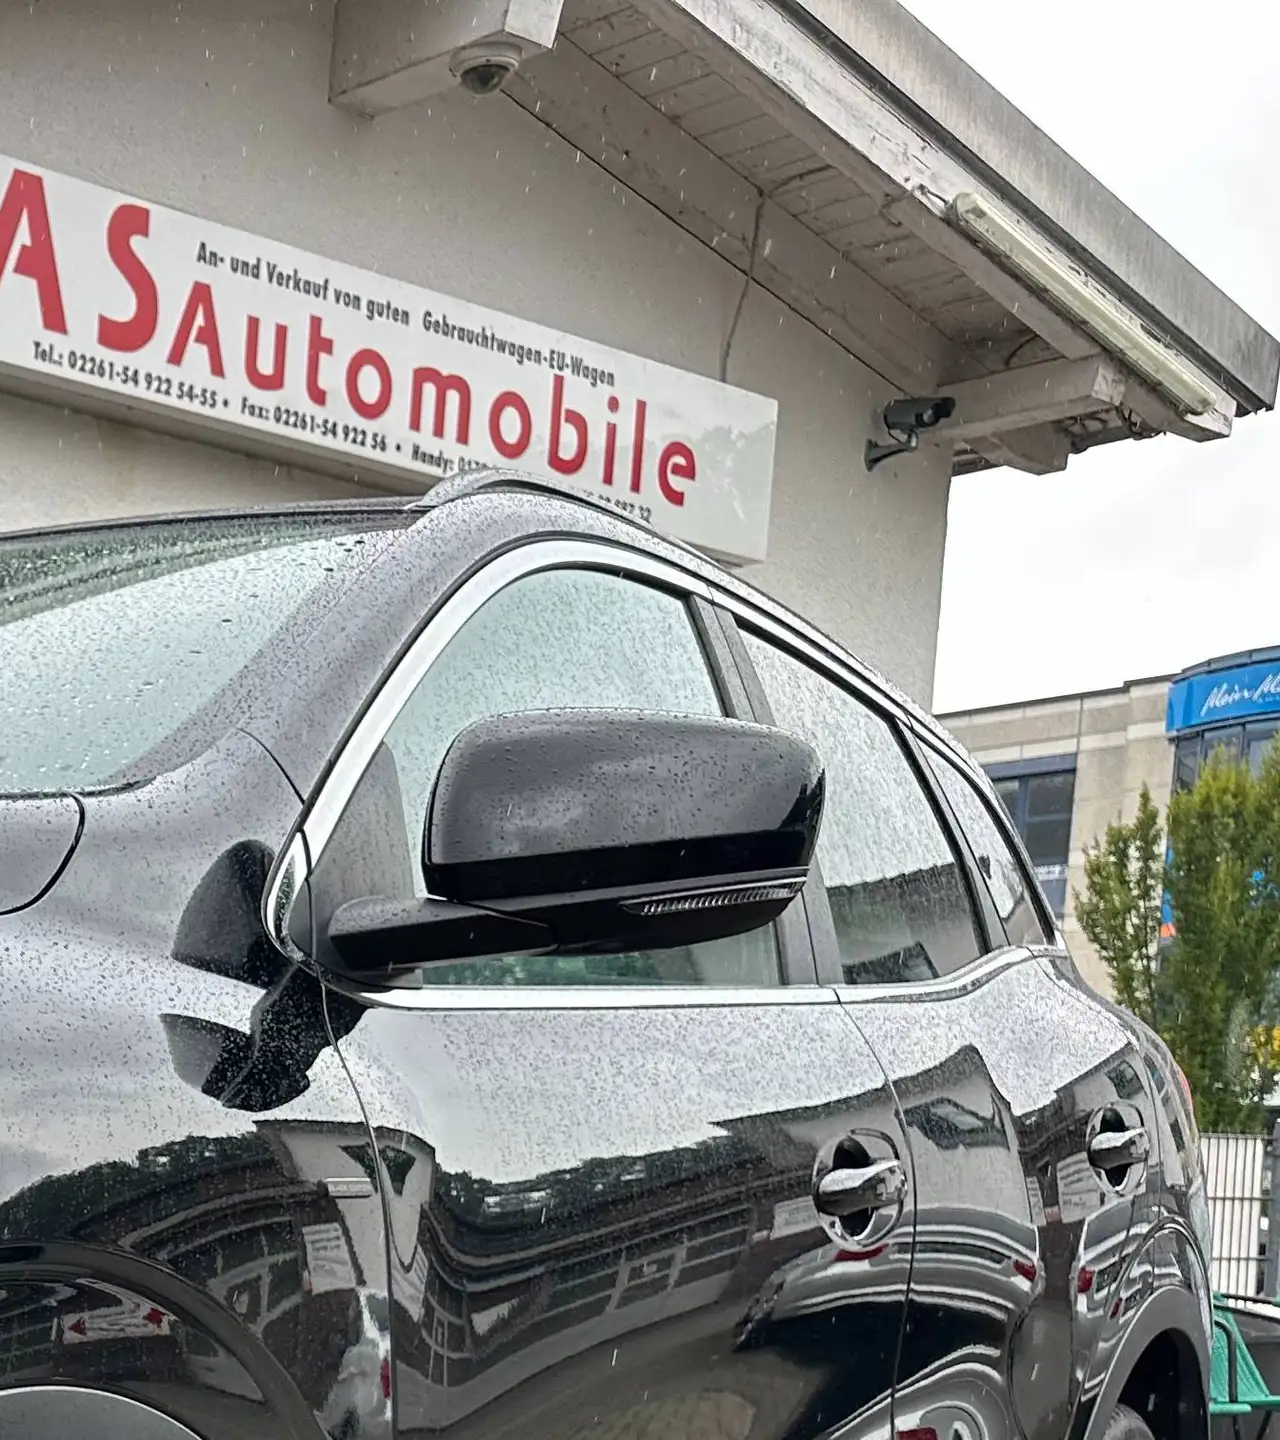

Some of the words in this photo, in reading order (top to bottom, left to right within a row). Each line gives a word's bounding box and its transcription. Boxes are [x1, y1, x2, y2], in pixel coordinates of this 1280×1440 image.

[197, 241, 225, 268] An-
[230, 257, 262, 280] und
[266, 261, 330, 300] Verkauf
[334, 287, 362, 311] von
[366, 298, 410, 326] guten
[68, 350, 139, 388] 02261-54
[144, 371, 173, 397] 922
[178, 382, 218, 409] 54-55
[241, 396, 270, 421] Fax:
[273, 405, 338, 439] 02261-54
[342, 424, 367, 447] 922
[371, 432, 387, 452] 56
[411, 442, 455, 475] Handy:
